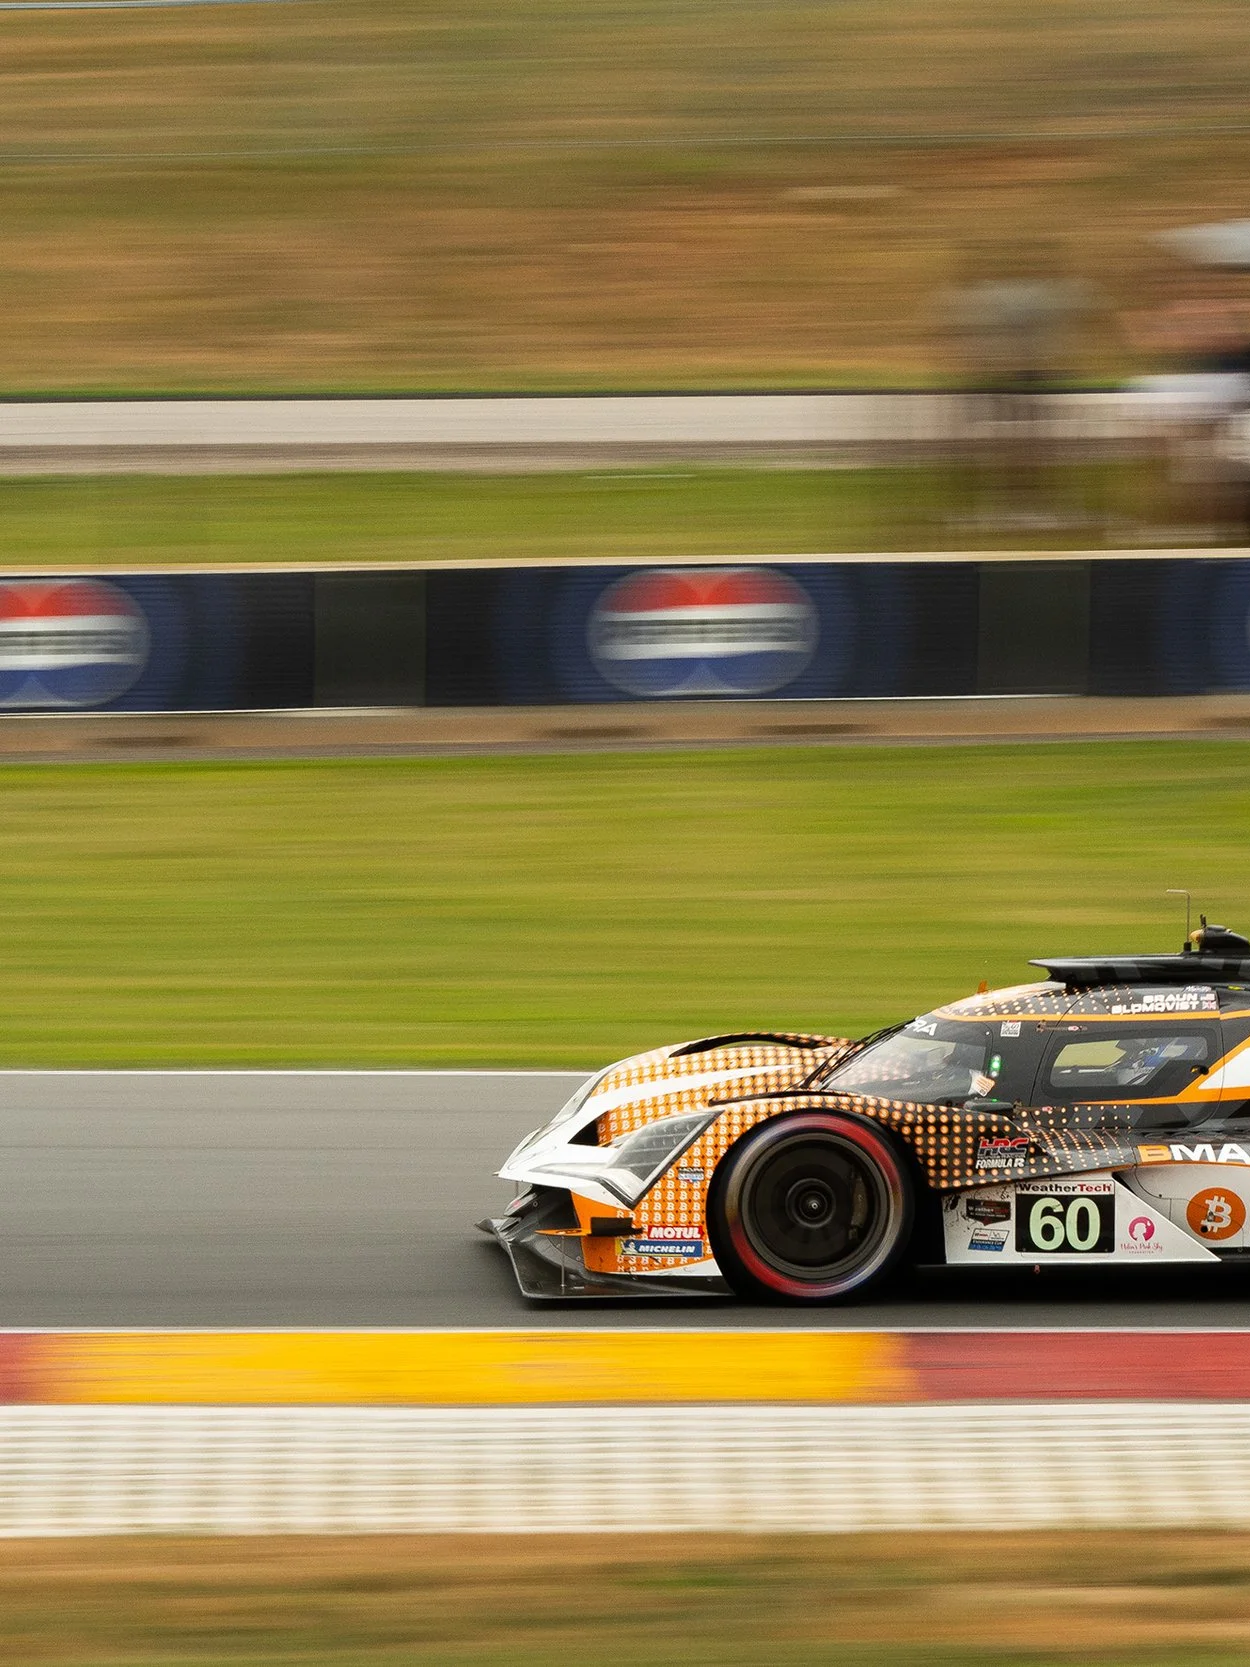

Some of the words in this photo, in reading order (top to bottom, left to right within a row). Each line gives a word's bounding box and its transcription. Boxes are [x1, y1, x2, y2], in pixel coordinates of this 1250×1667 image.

[1142, 993, 1198, 1004] BRAUN
[977, 1138, 1029, 1155] HRC
[975, 1158, 1013, 1169] FORMULA
[1019, 1183, 1112, 1193] WeatherTech
[1029, 1197, 1101, 1251] 60
[649, 1226, 702, 1239] MOTUL
[638, 1245, 696, 1254] MICHELIN
